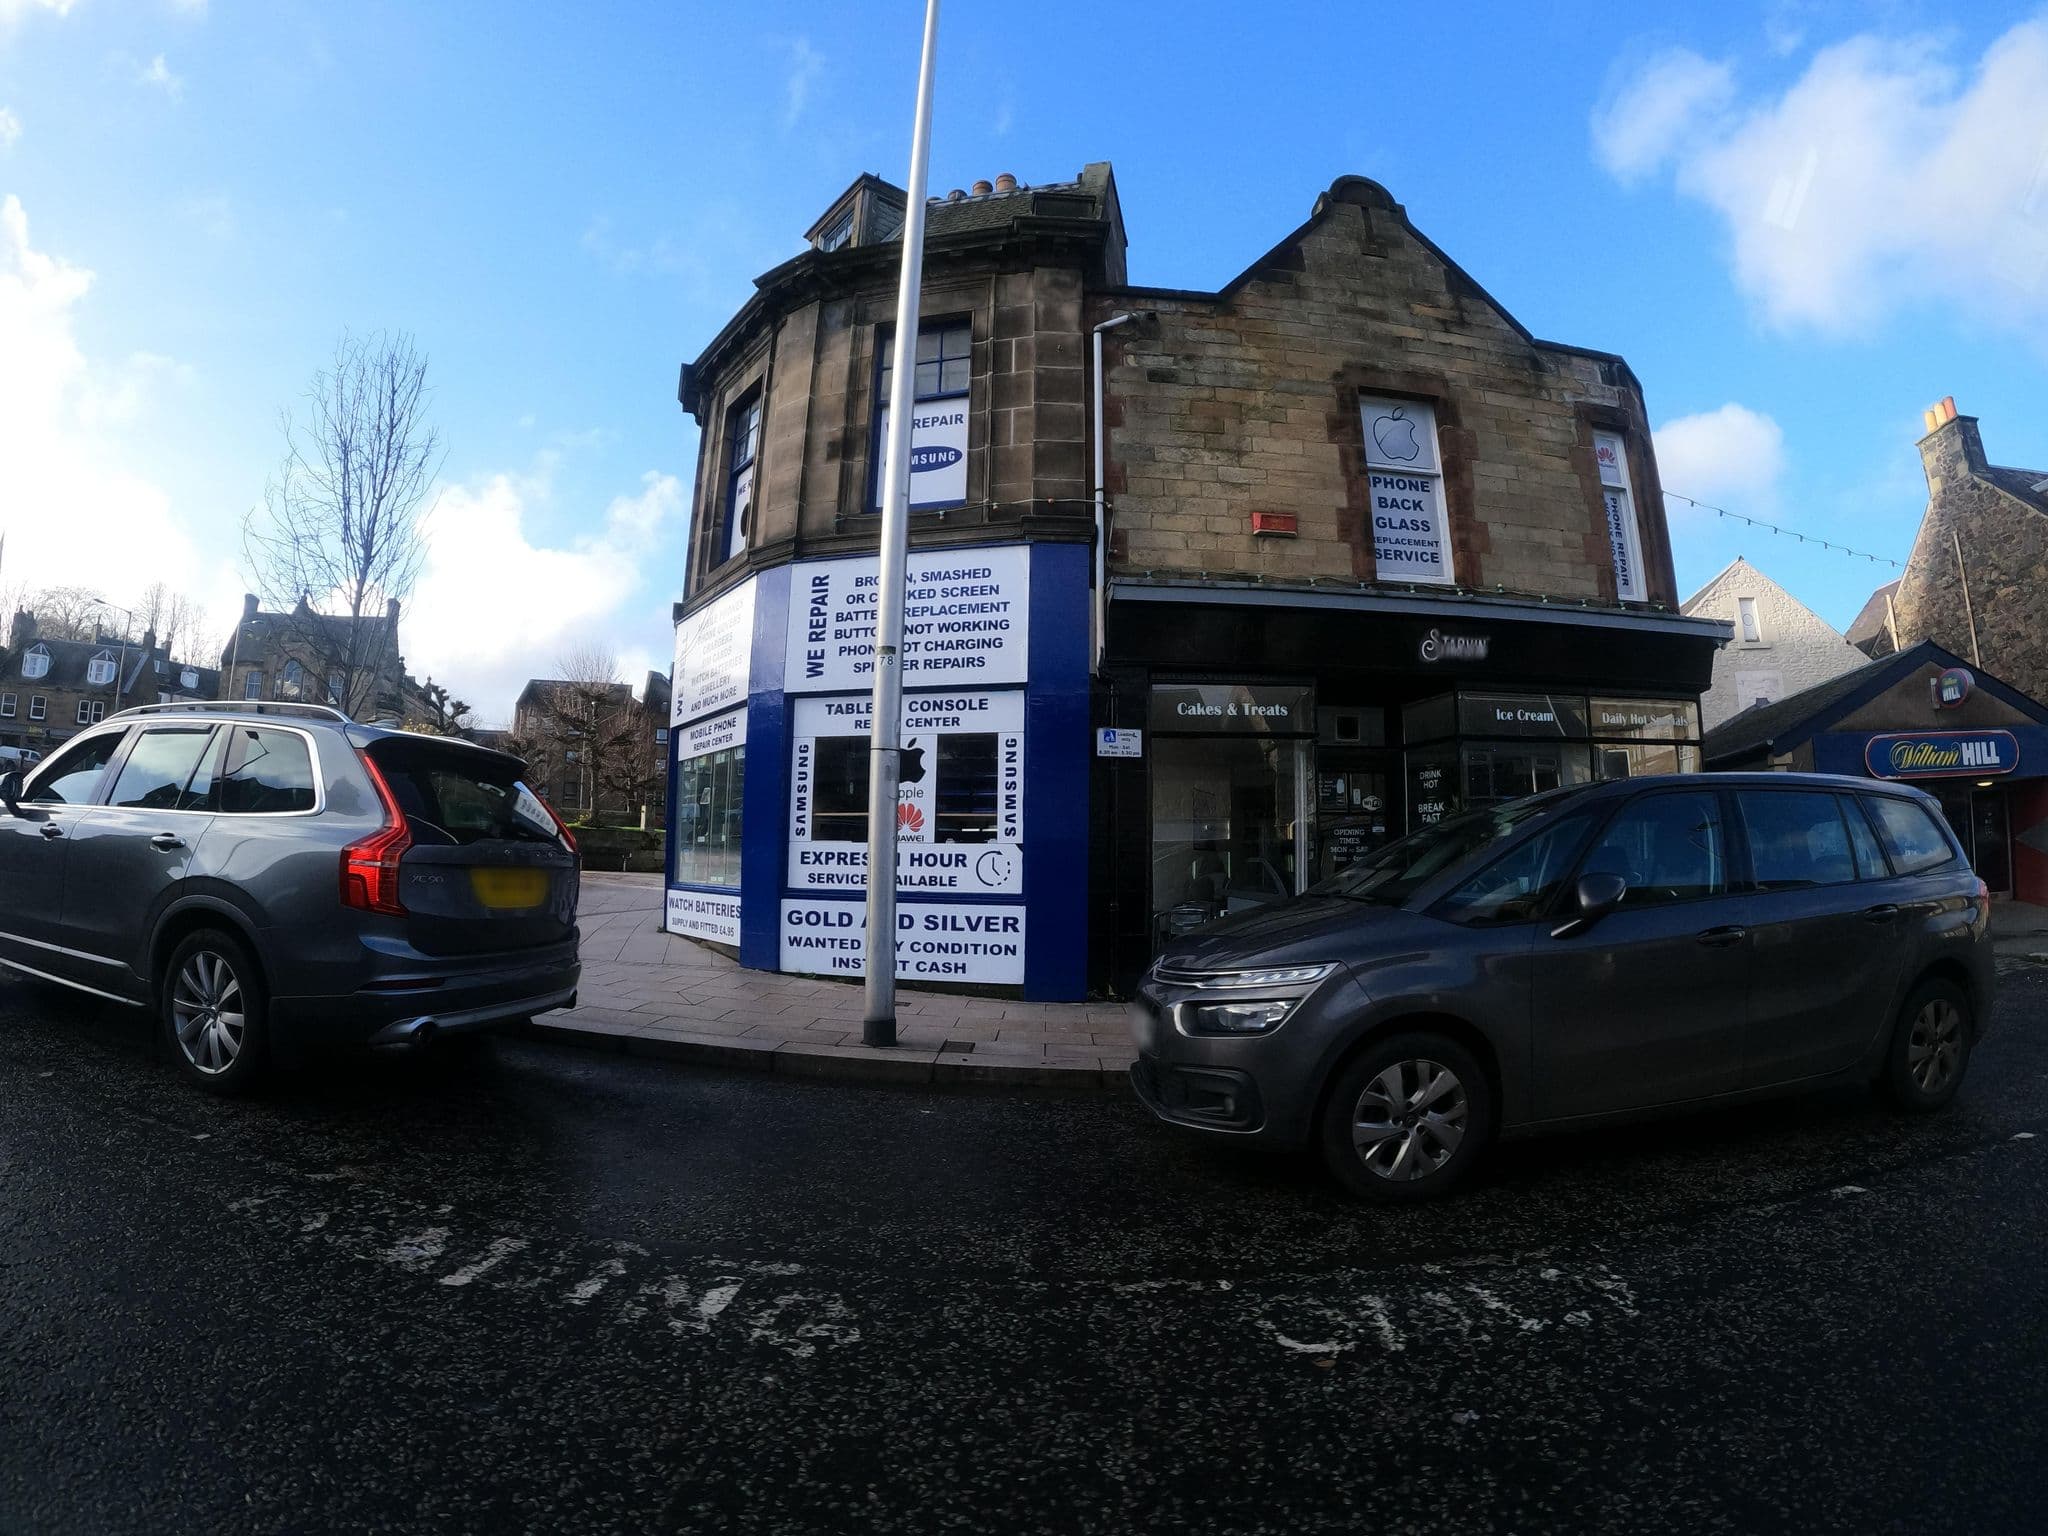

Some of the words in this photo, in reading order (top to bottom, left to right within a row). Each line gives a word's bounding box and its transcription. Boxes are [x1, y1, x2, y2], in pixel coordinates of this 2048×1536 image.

[912, 413, 964, 430] REPAIR
[911, 451, 956, 465] MSUNG
[1377, 496, 1424, 512] BACK
[1375, 516, 1431, 532] GLASS
[1610, 497, 1623, 539] PHONE
[1375, 548, 1440, 564] SERVICE
[1616, 542, 1629, 586] REPAIR
[854, 572, 917, 588] BRON,
[920, 568, 992, 583] SMASHED
[846, 594, 866, 605] OR
[868, 588, 937, 604] CKED
[940, 584, 1000, 598] SCREEN
[808, 574, 830, 642] REPAIR
[902, 602, 1010, 618] REPLACEMENT
[903, 623, 934, 635] NOT
[938, 619, 1010, 632] WORKING
[838, 644, 876, 656] PHON
[902, 641, 920, 652] OT
[924, 637, 1004, 652] CHARGING
[806, 648, 825, 679] WE
[922, 656, 986, 670] REPAIRS
[690, 700, 702, 713] AND
[702, 691, 719, 708] MUCH
[720, 686, 737, 700] MORE
[825, 702, 873, 715] TABLE
[908, 698, 989, 713] CONSOLE
[1176, 702, 1222, 717] Cakes
[1226, 702, 1238, 716] &
[1242, 703, 1288, 717] Treats
[1496, 708, 1514, 722] Ice
[1516, 709, 1554, 722] Cream
[906, 716, 960, 728] CENTER
[1602, 711, 1628, 728] Daily
[1630, 713, 1647, 726] Hot
[1650, 714, 1689, 727] Sals
[690, 725, 712, 741] MOBILE
[713, 716, 737, 734] PHONE
[712, 733, 734, 747] CENTER
[1892, 740, 1960, 769] William
[1962, 741, 2000, 766] HILL
[1419, 769, 1442, 780] DRINK
[795, 744, 810, 837] SAMSUNG
[898, 786, 924, 800] pple
[1004, 737, 1018, 837] SAMSUNG
[1423, 780, 1438, 790] HOT
[1418, 802, 1445, 814] BREAK
[1422, 812, 1441, 824] FAST
[896, 834, 924, 842] AWEI
[1333, 828, 1366, 836] OPENING
[800, 852, 868, 866] EXPRES
[910, 853, 968, 868] HOUR
[808, 872, 868, 886] SERVICE
[896, 875, 958, 886] AILABLE
[668, 896, 694, 912] WATCH
[696, 900, 742, 919] BATTERIES
[787, 910, 853, 928] GOLD
[924, 915, 1020, 933] SILVER
[788, 936, 861, 950] WANTED
[910, 941, 1017, 956] CONDITION
[915, 960, 967, 974] CASH
